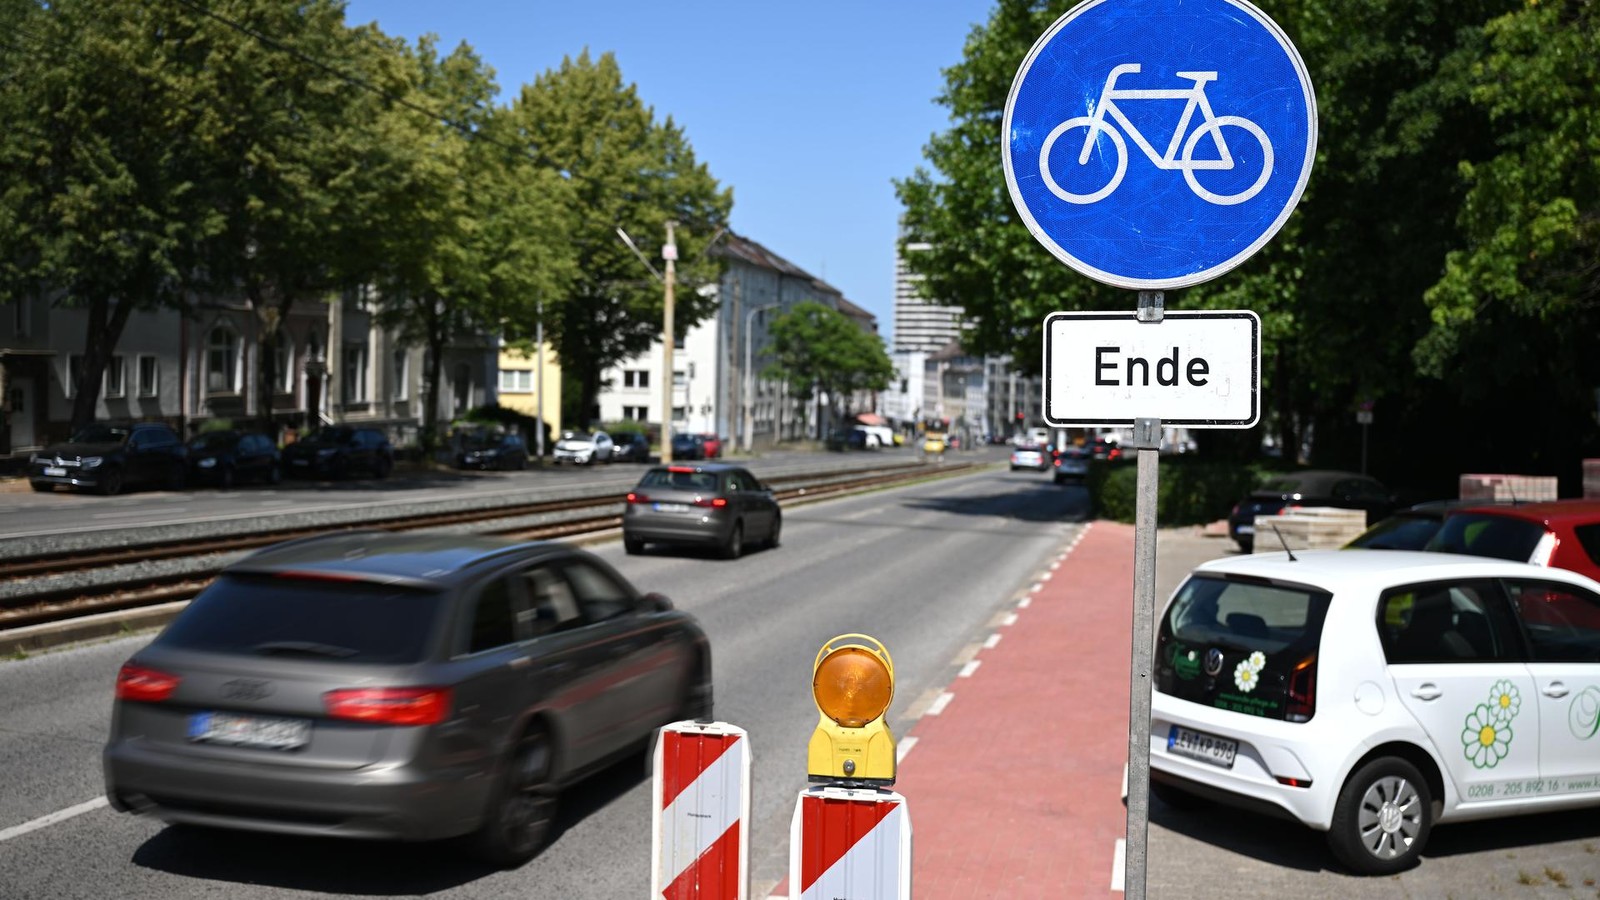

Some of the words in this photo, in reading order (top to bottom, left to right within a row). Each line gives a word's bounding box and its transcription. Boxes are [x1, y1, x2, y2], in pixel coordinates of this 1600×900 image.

[1095, 346, 1210, 386] Ende
[1213, 740, 1233, 760] 896
[1467, 784, 1494, 798] 0208
[1503, 781, 1522, 795] 205
[1525, 779, 1544, 793] 892
[1548, 779, 1559, 792] 16
[1568, 775, 1600, 790] www.k
